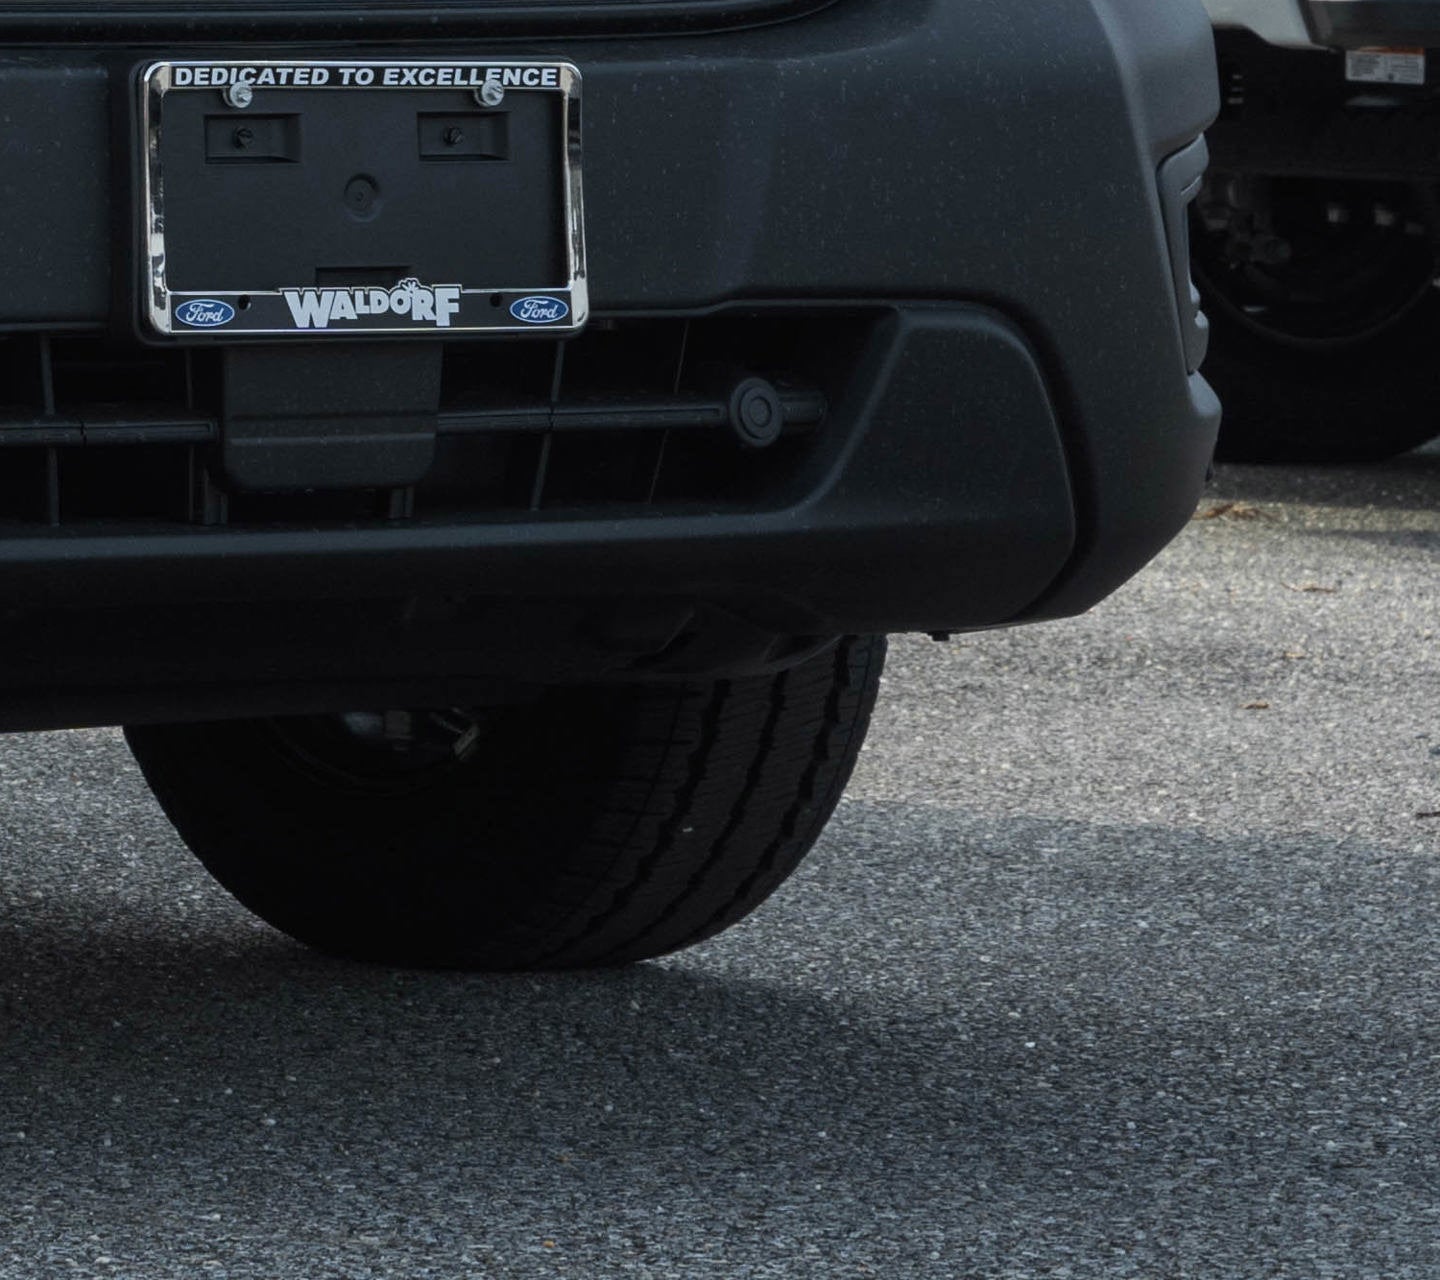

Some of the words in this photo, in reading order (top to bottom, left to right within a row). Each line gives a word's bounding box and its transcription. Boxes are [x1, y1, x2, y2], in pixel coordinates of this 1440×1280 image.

[175, 68, 330, 86] DEDICATED
[339, 68, 375, 86] TO
[383, 68, 558, 86] EXCELLENCE
[185, 301, 225, 325] Ford
[284, 286, 460, 328] WALDORF
[521, 298, 560, 322] Ford
